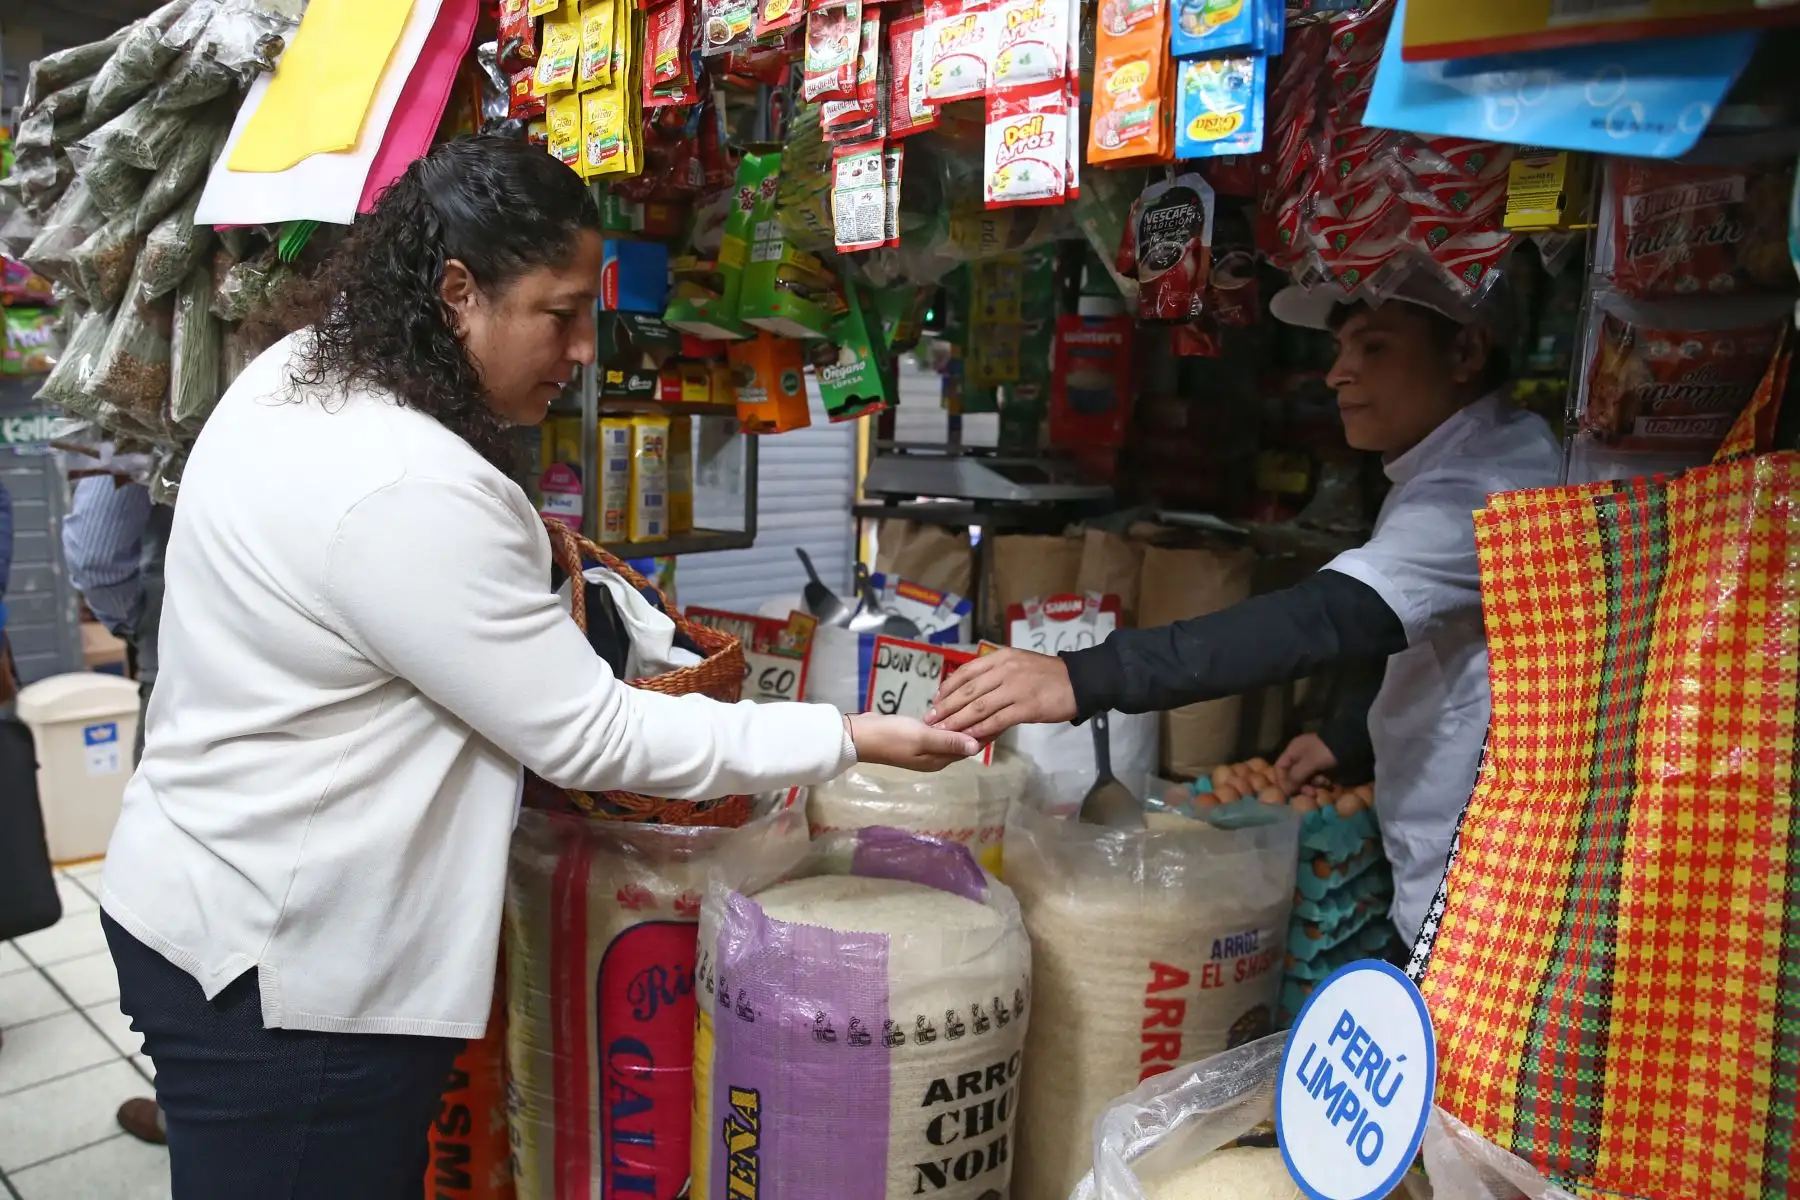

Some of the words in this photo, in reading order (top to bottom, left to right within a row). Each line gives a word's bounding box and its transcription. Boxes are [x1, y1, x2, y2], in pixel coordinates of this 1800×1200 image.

[996, 131, 1055, 165] Arroz
[1004, 115, 1044, 147] Deli
[1210, 928, 1260, 960] ARROZ
[627, 962, 697, 1022] Ri
[1200, 962, 1225, 989] EL
[921, 1049, 1021, 1107] ARRO
[1327, 1008, 1408, 1108] PERÚ
[1296, 1042, 1384, 1167] LIMPIO
